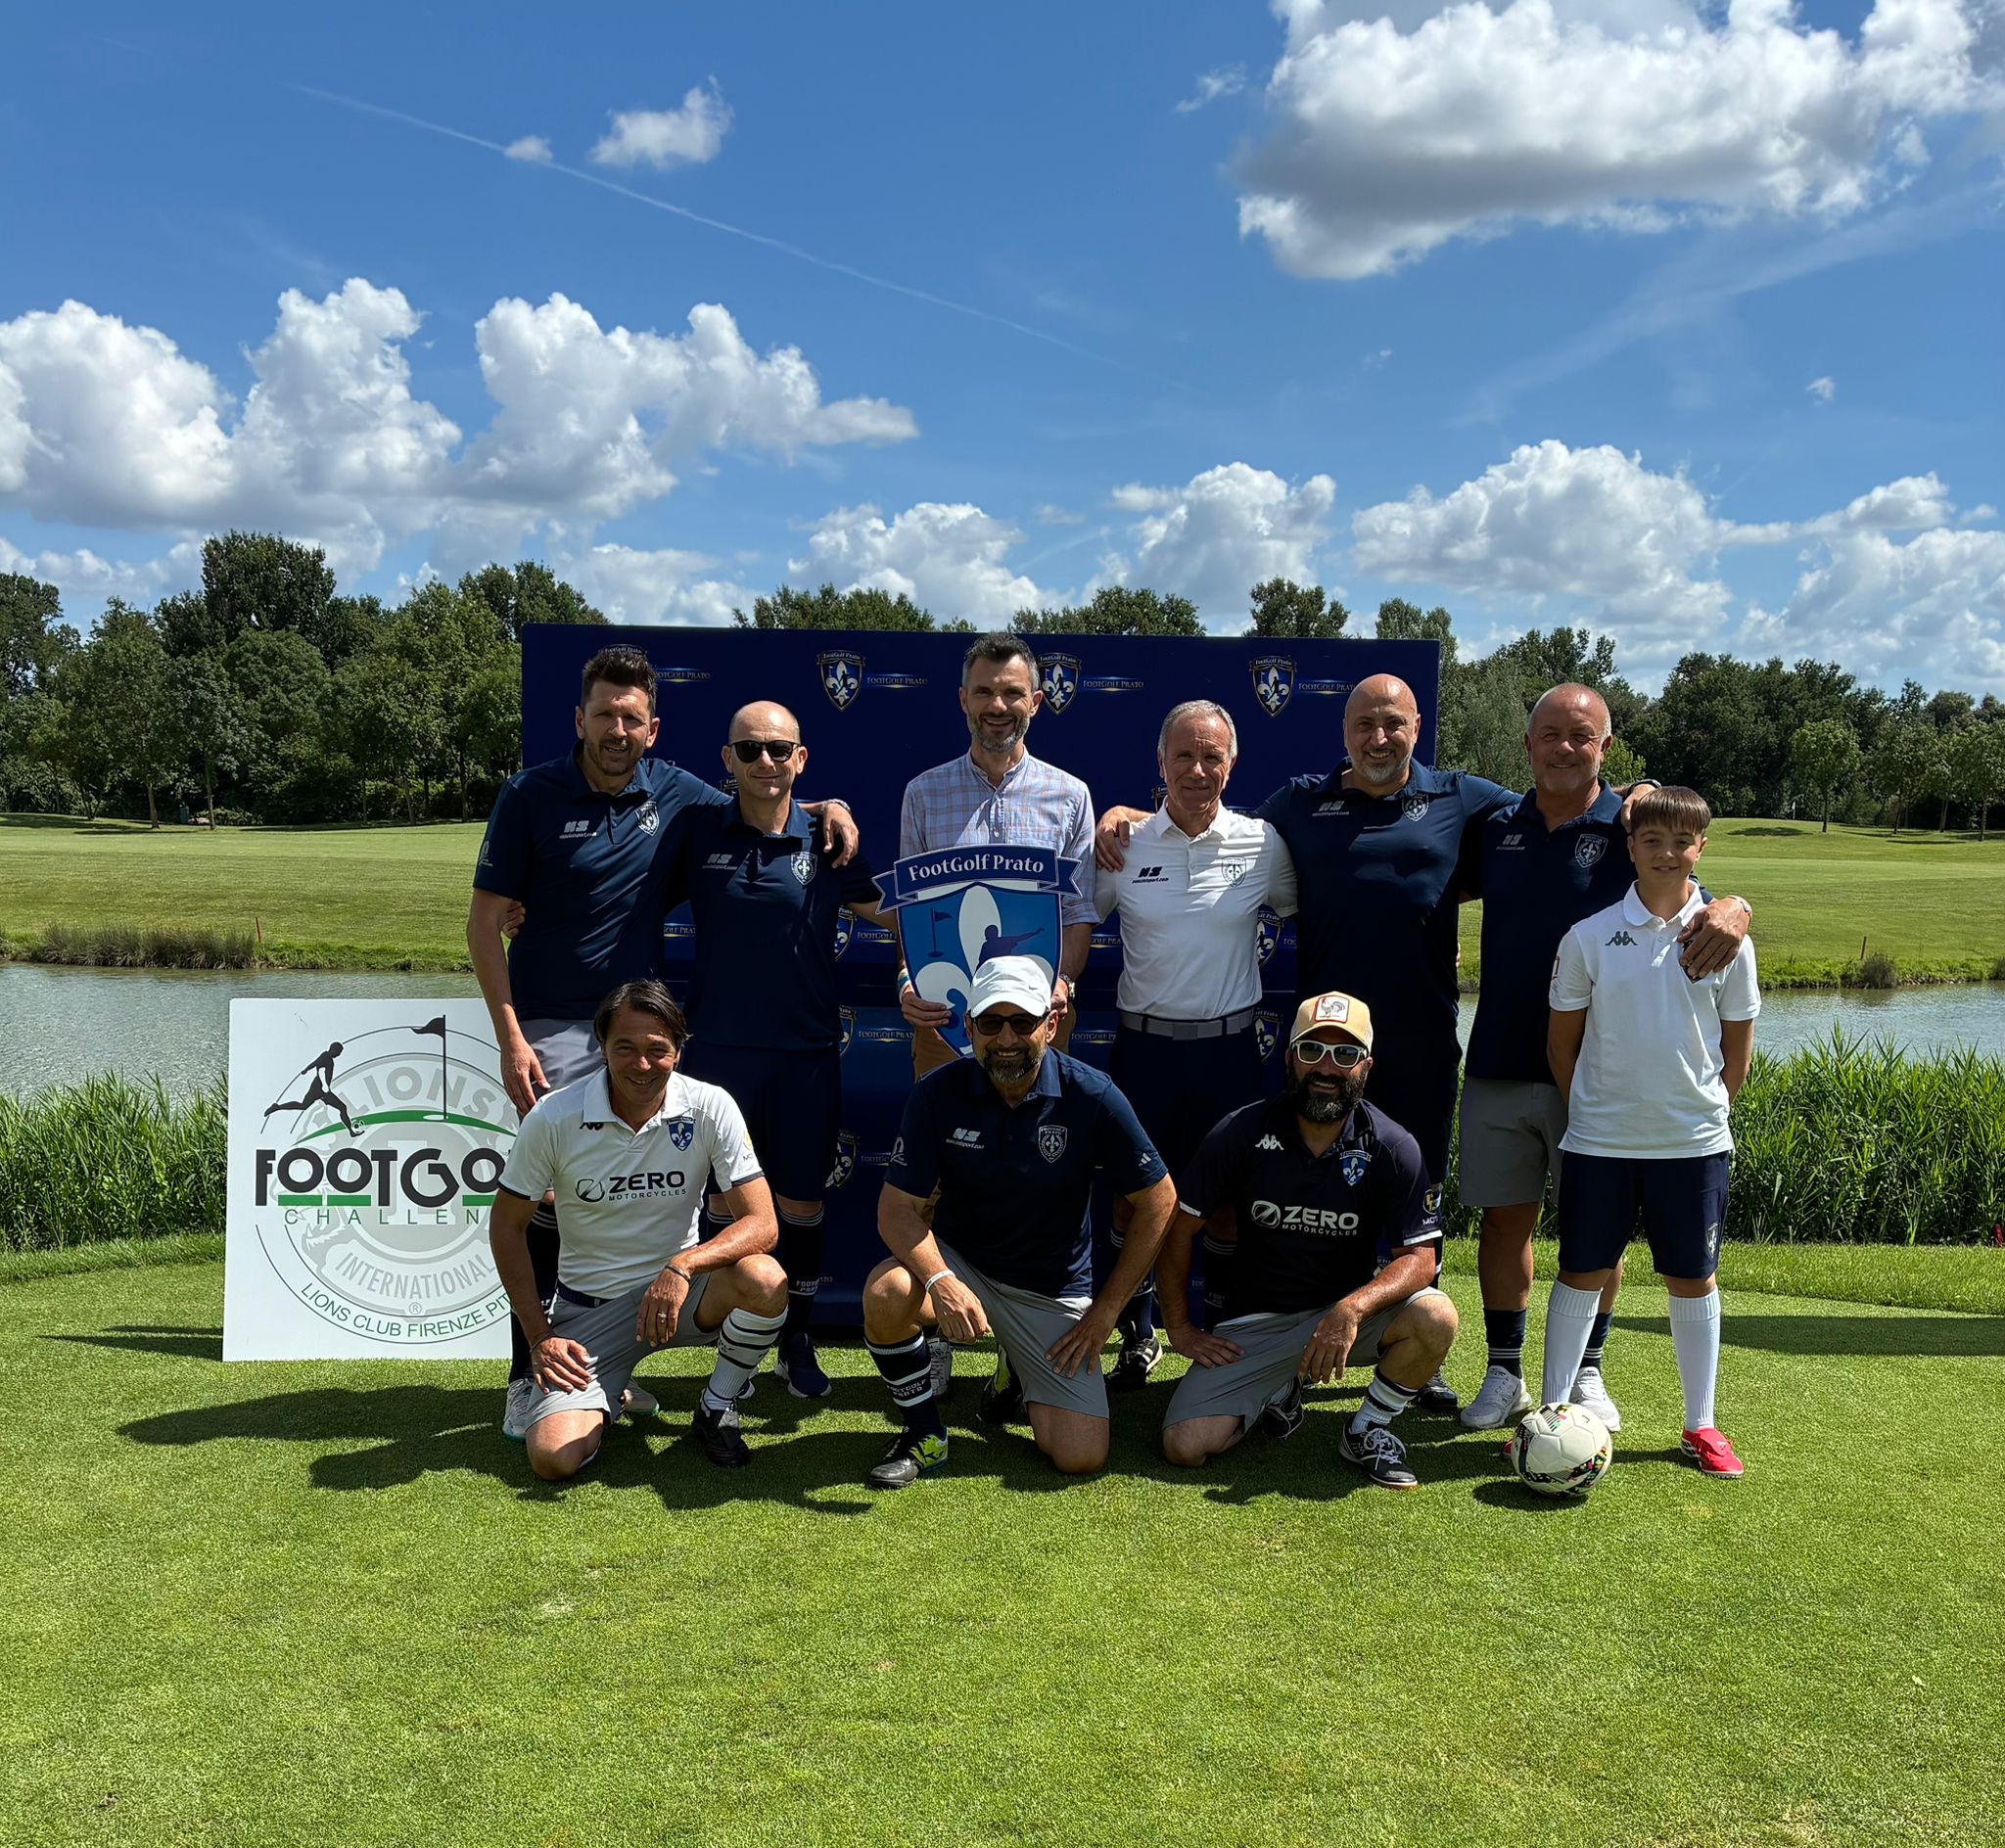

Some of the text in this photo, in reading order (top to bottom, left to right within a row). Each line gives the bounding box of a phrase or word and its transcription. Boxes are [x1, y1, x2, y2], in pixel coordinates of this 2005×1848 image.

[656, 670, 685, 679] OTGOLF
[1335, 682, 1356, 691] PRAT
[908, 853, 1045, 882] FootGolf Prato
[338, 1066, 497, 1119] LIONS
[255, 1147, 507, 1208] FOOTGO
[608, 1170, 685, 1194] ZERO
[608, 1188, 687, 1202] MOTORCYCLES
[284, 1208, 480, 1224] CHALLEN
[1282, 1205, 1359, 1230] ZERO
[1282, 1223, 1358, 1237] MOTORCYCLES
[335, 1251, 497, 1300] INTERNATIONAL
[301, 1282, 511, 1338] LIONS CLUB FIRENZE PIT
